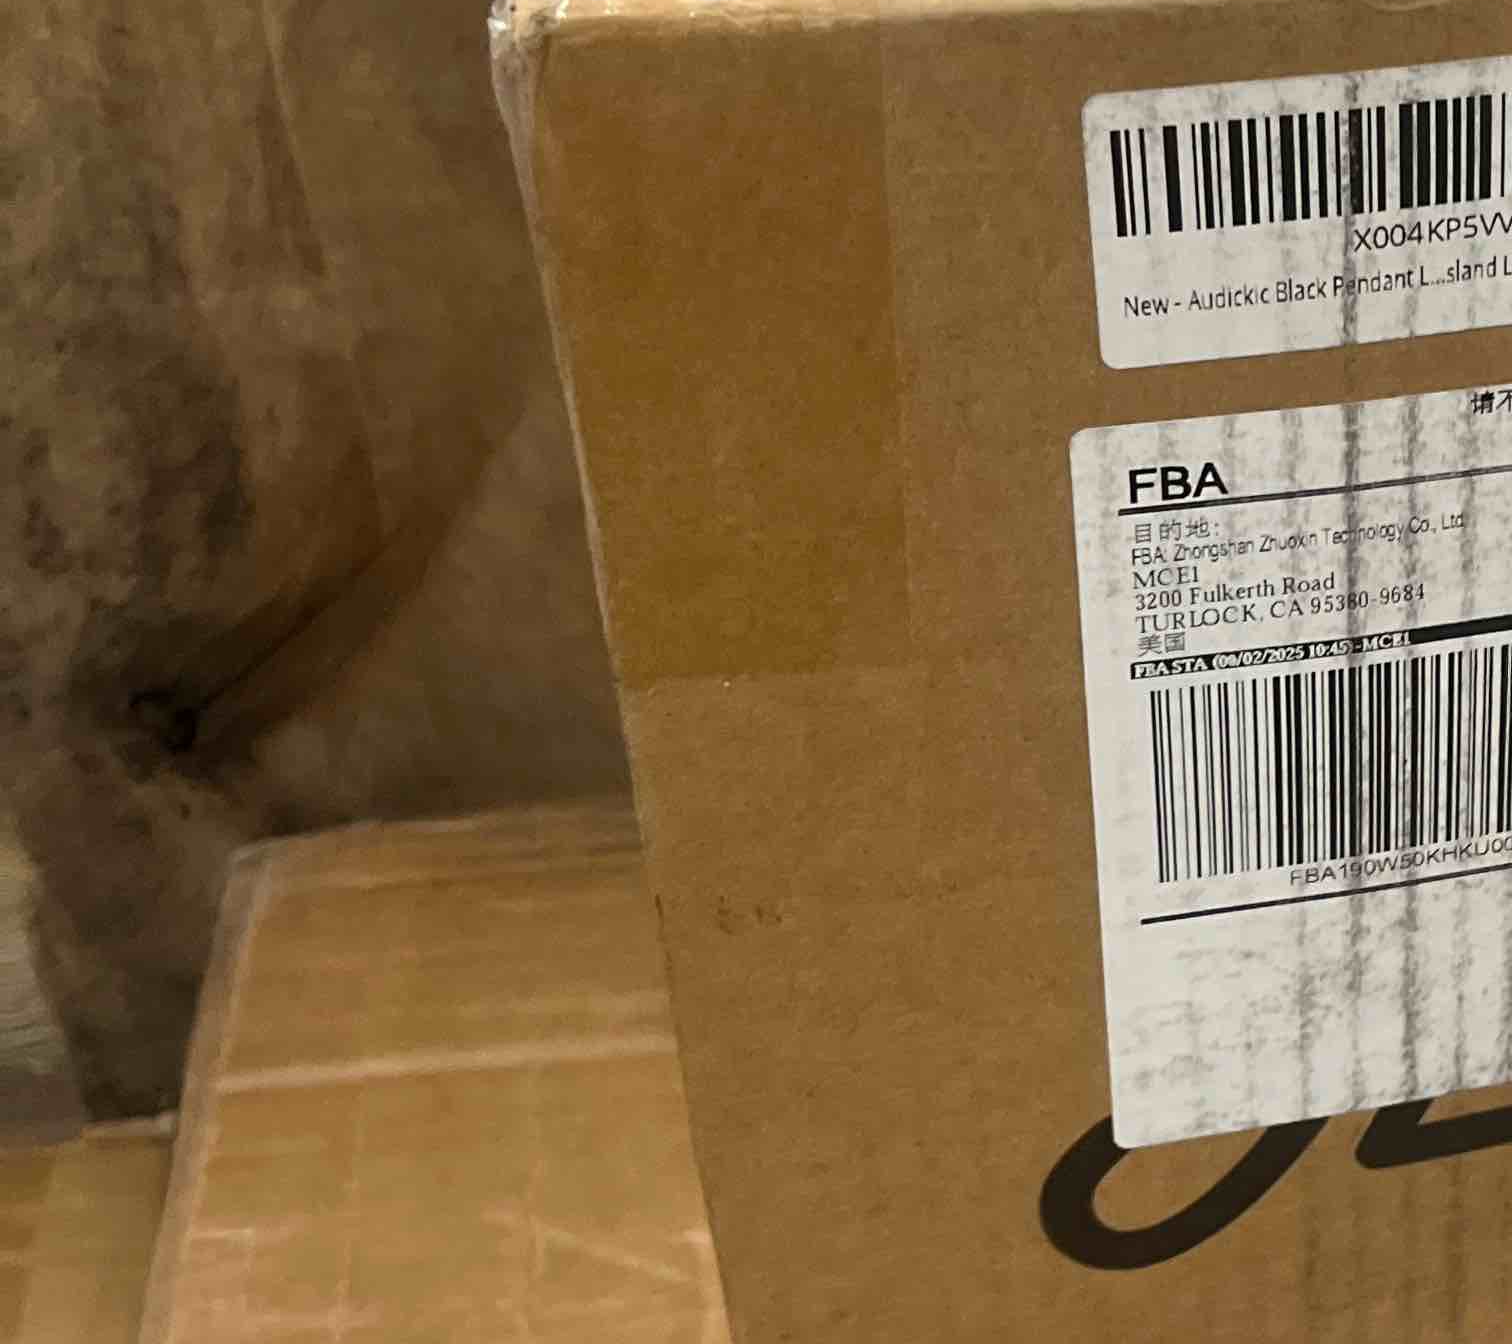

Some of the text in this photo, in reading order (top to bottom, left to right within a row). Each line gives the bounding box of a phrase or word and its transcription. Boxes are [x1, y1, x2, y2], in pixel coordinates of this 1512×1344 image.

[1124, 295, 1170, 318] New
[1188, 286, 1270, 312] Audickic
[1275, 277, 1327, 303] Black
[1332, 269, 1414, 298] Pendant
[1127, 461, 1229, 505] FBA
[1135, 571, 1336, 612] 3200 Fulkerth Road
[1270, 599, 1304, 619] CA
